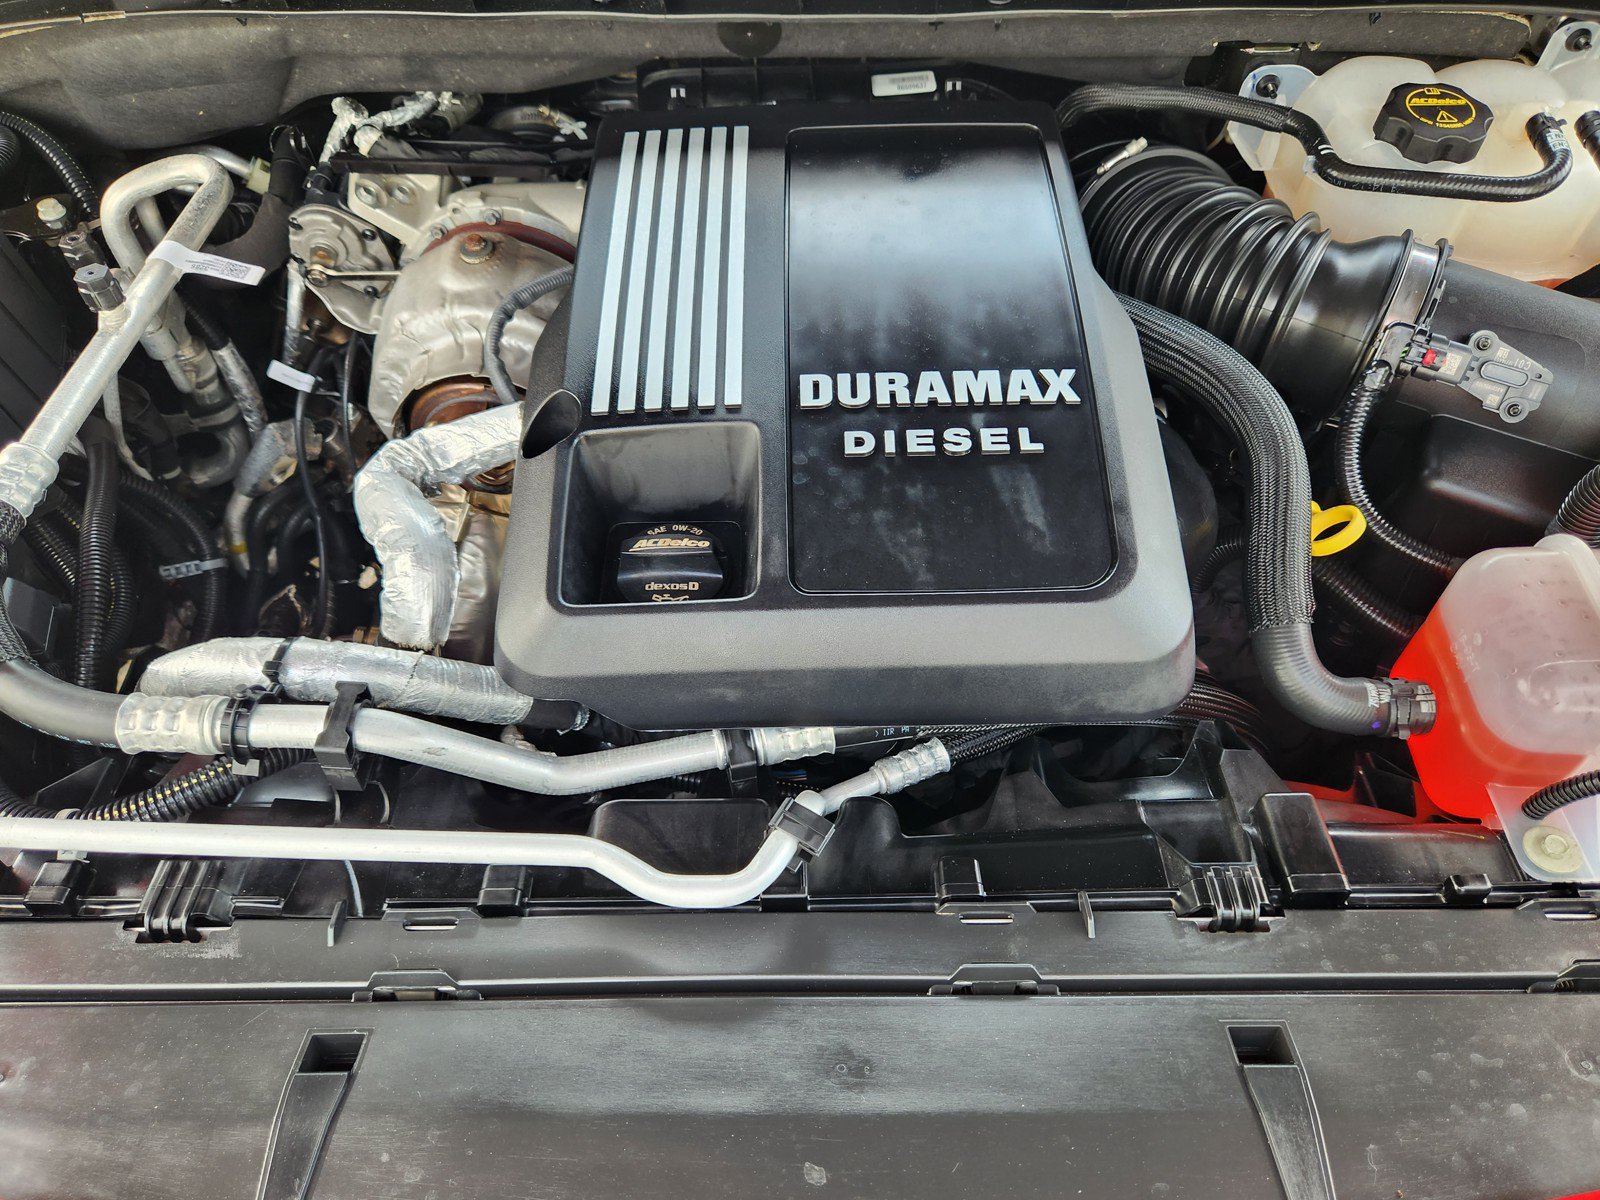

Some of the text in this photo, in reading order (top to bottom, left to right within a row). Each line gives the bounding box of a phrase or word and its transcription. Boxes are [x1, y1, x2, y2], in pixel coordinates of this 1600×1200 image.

[1409, 97, 1467, 106] ACDelco
[799, 368, 1081, 410] DURAMAX
[843, 427, 1045, 458] DIESEL
[646, 524, 704, 536] SAE 0W-20
[631, 537, 711, 550] ACDelco
